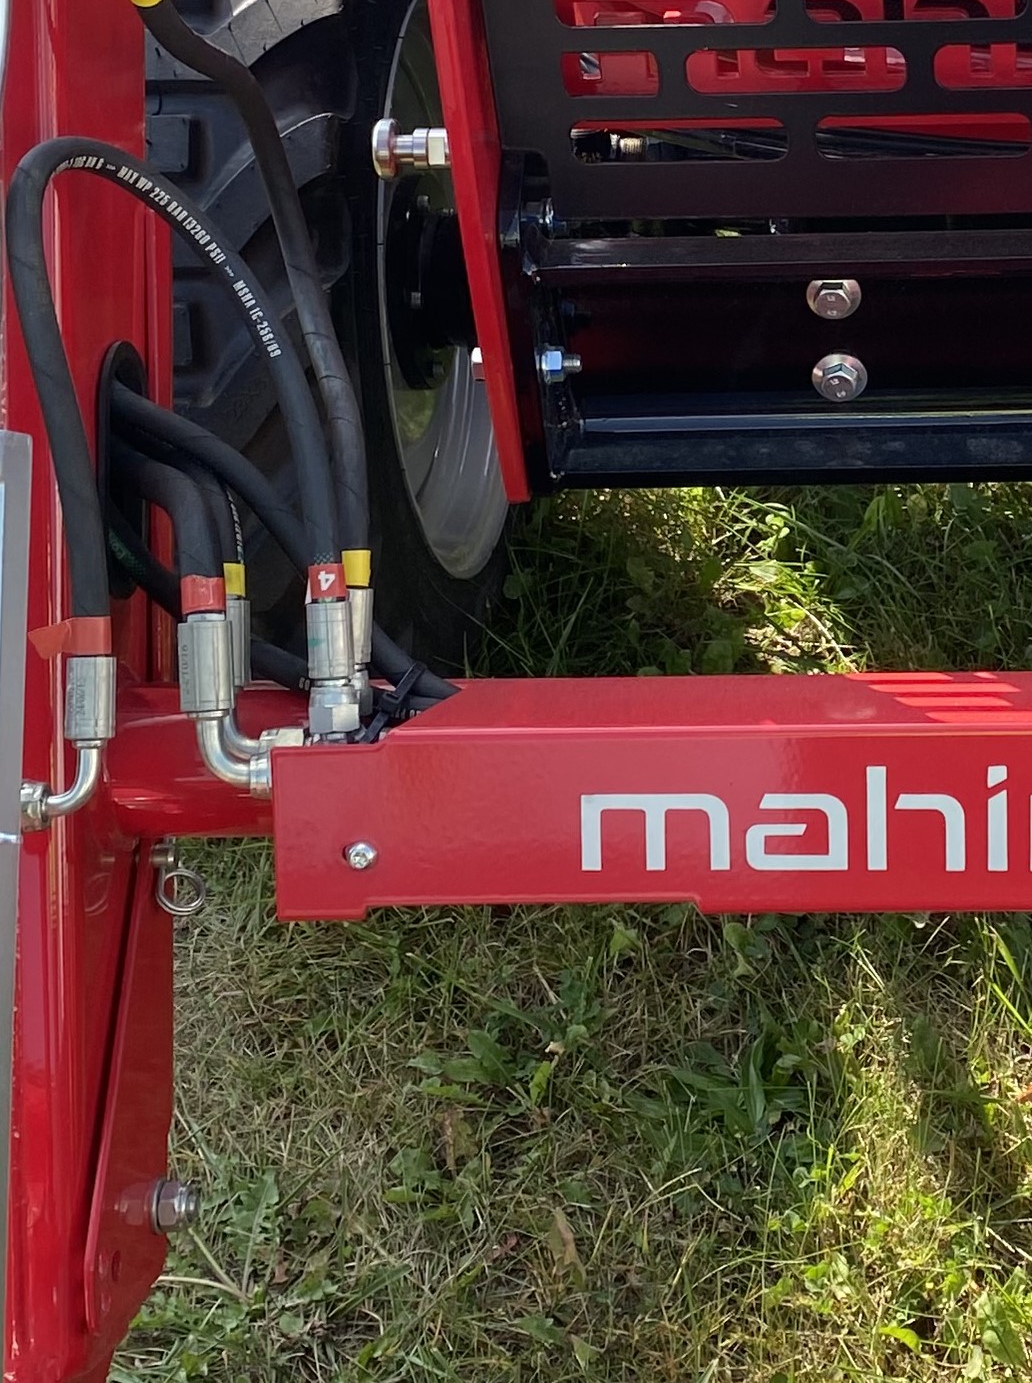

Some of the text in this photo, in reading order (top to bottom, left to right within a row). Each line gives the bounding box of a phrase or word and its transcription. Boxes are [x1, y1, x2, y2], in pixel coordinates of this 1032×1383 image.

[116, 165, 140, 184] MAX
[135, 176, 153, 192] WP
[149, 187, 171, 206] 225
[166, 201, 188, 222] BAR
[182, 216, 211, 245] (3260
[204, 241, 227, 264] PSI)
[232, 279, 256, 309] MSHA
[317, 570, 336, 592] 4
